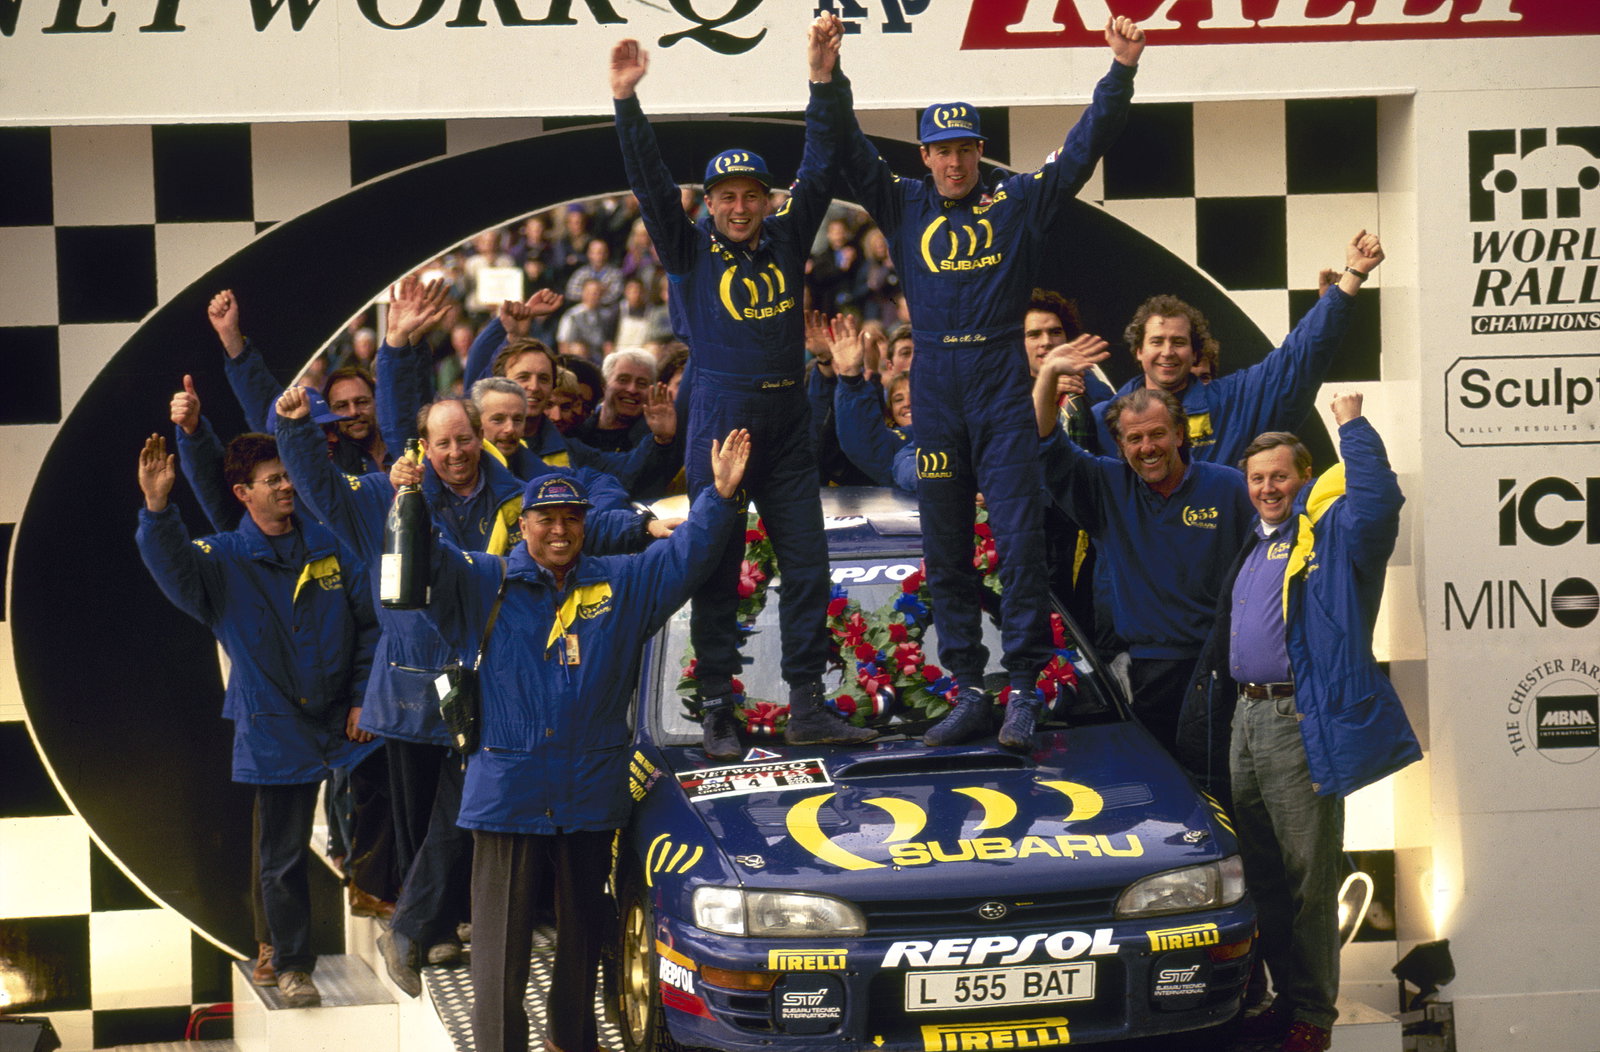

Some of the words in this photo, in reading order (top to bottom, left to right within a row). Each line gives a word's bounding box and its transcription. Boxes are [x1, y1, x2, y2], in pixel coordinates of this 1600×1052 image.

[940, 253, 1002, 271] SUBARU
[743, 296, 795, 319] SUBARU
[1474, 313, 1600, 333] CHAMPIONS
[1460, 367, 1600, 414] Sculp
[1571, 658, 1600, 683] PAR
[1508, 658, 1565, 715] CHESTER
[1540, 709, 1596, 726] MBNA
[1506, 720, 1526, 757] THE
[693, 764, 786, 781] NETWORK
[789, 762, 808, 771] Q
[748, 779, 761, 788] 4
[889, 834, 1144, 866] SUBARU
[881, 928, 1120, 968] REPSOL
[1145, 922, 1220, 952] PIRELLI
[768, 949, 848, 970] PIRELLI
[659, 956, 695, 994] REPSOL
[919, 978, 937, 1005] L
[954, 974, 1007, 1003] 555
[1023, 969, 1081, 999] BAT
[920, 1016, 1070, 1052] PIRELLI
